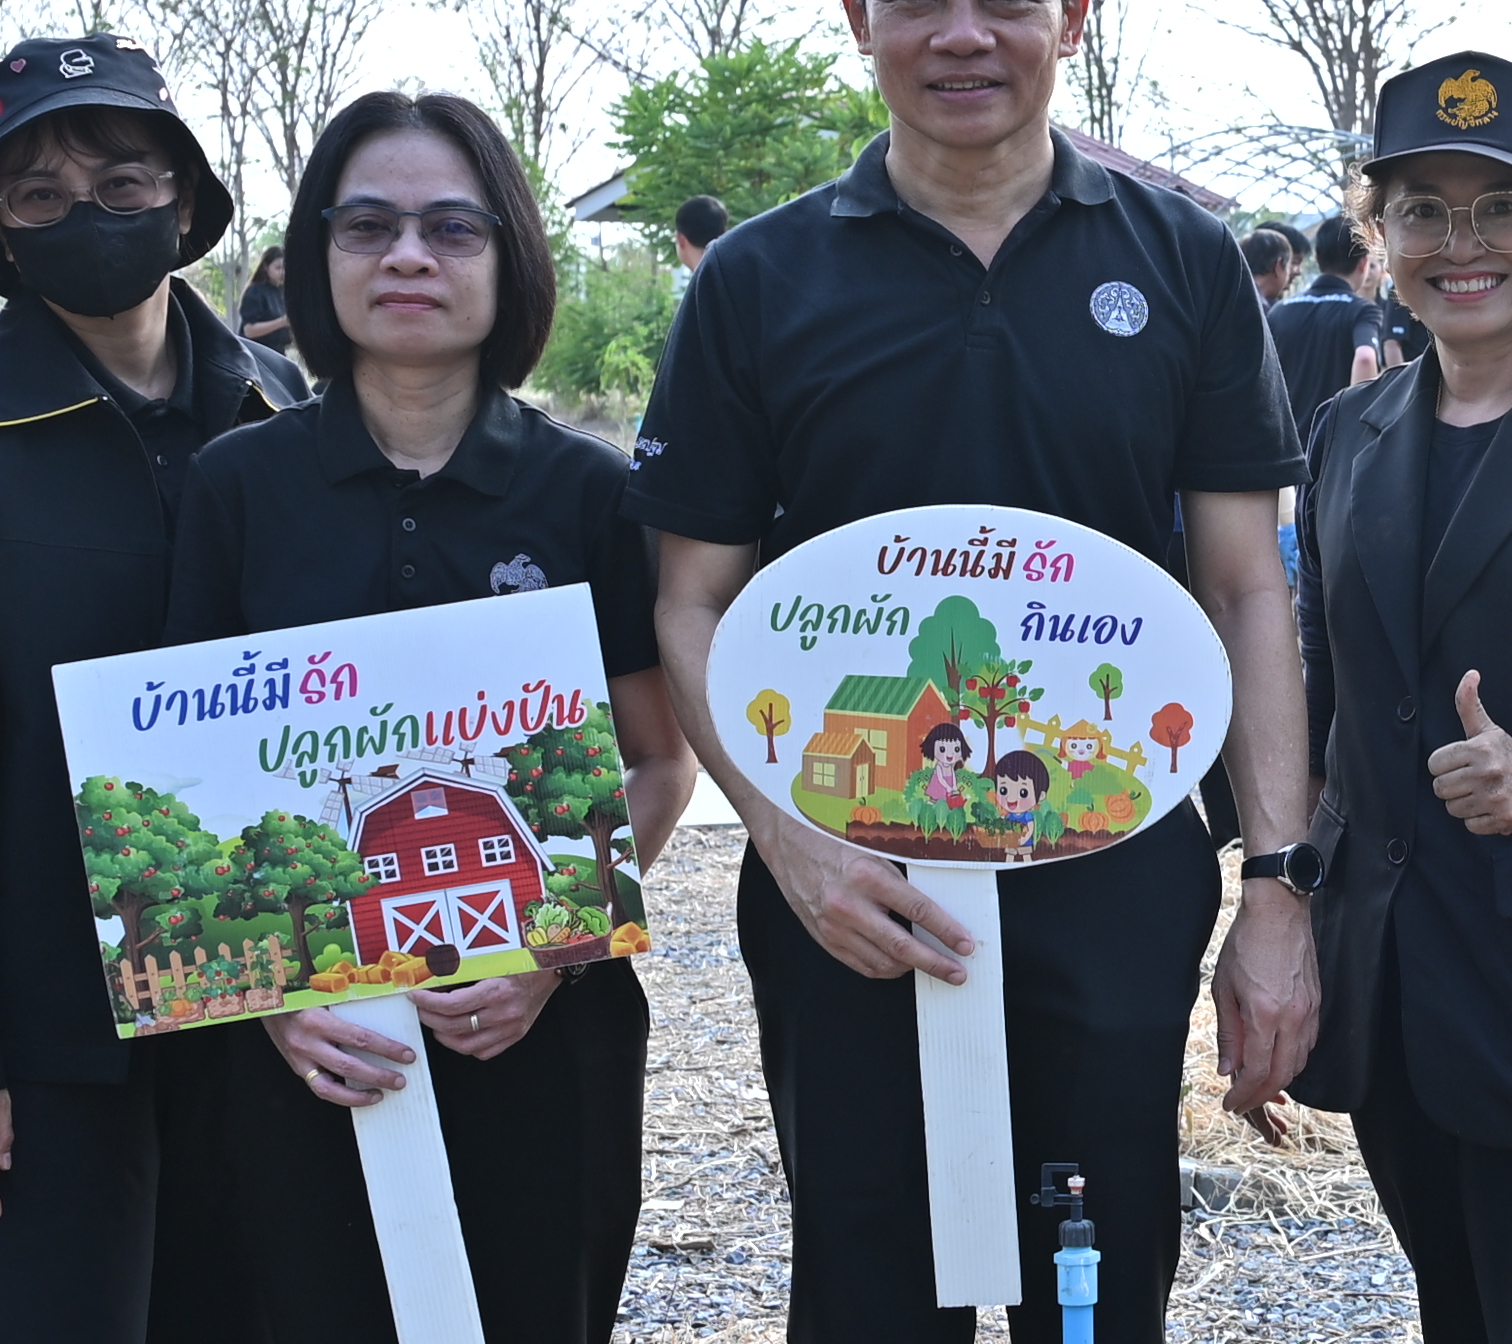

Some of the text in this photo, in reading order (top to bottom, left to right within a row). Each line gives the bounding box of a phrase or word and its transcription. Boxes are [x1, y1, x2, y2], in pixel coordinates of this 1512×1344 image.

[769, 594, 1143, 651] ปลูกผัก กินเอง
